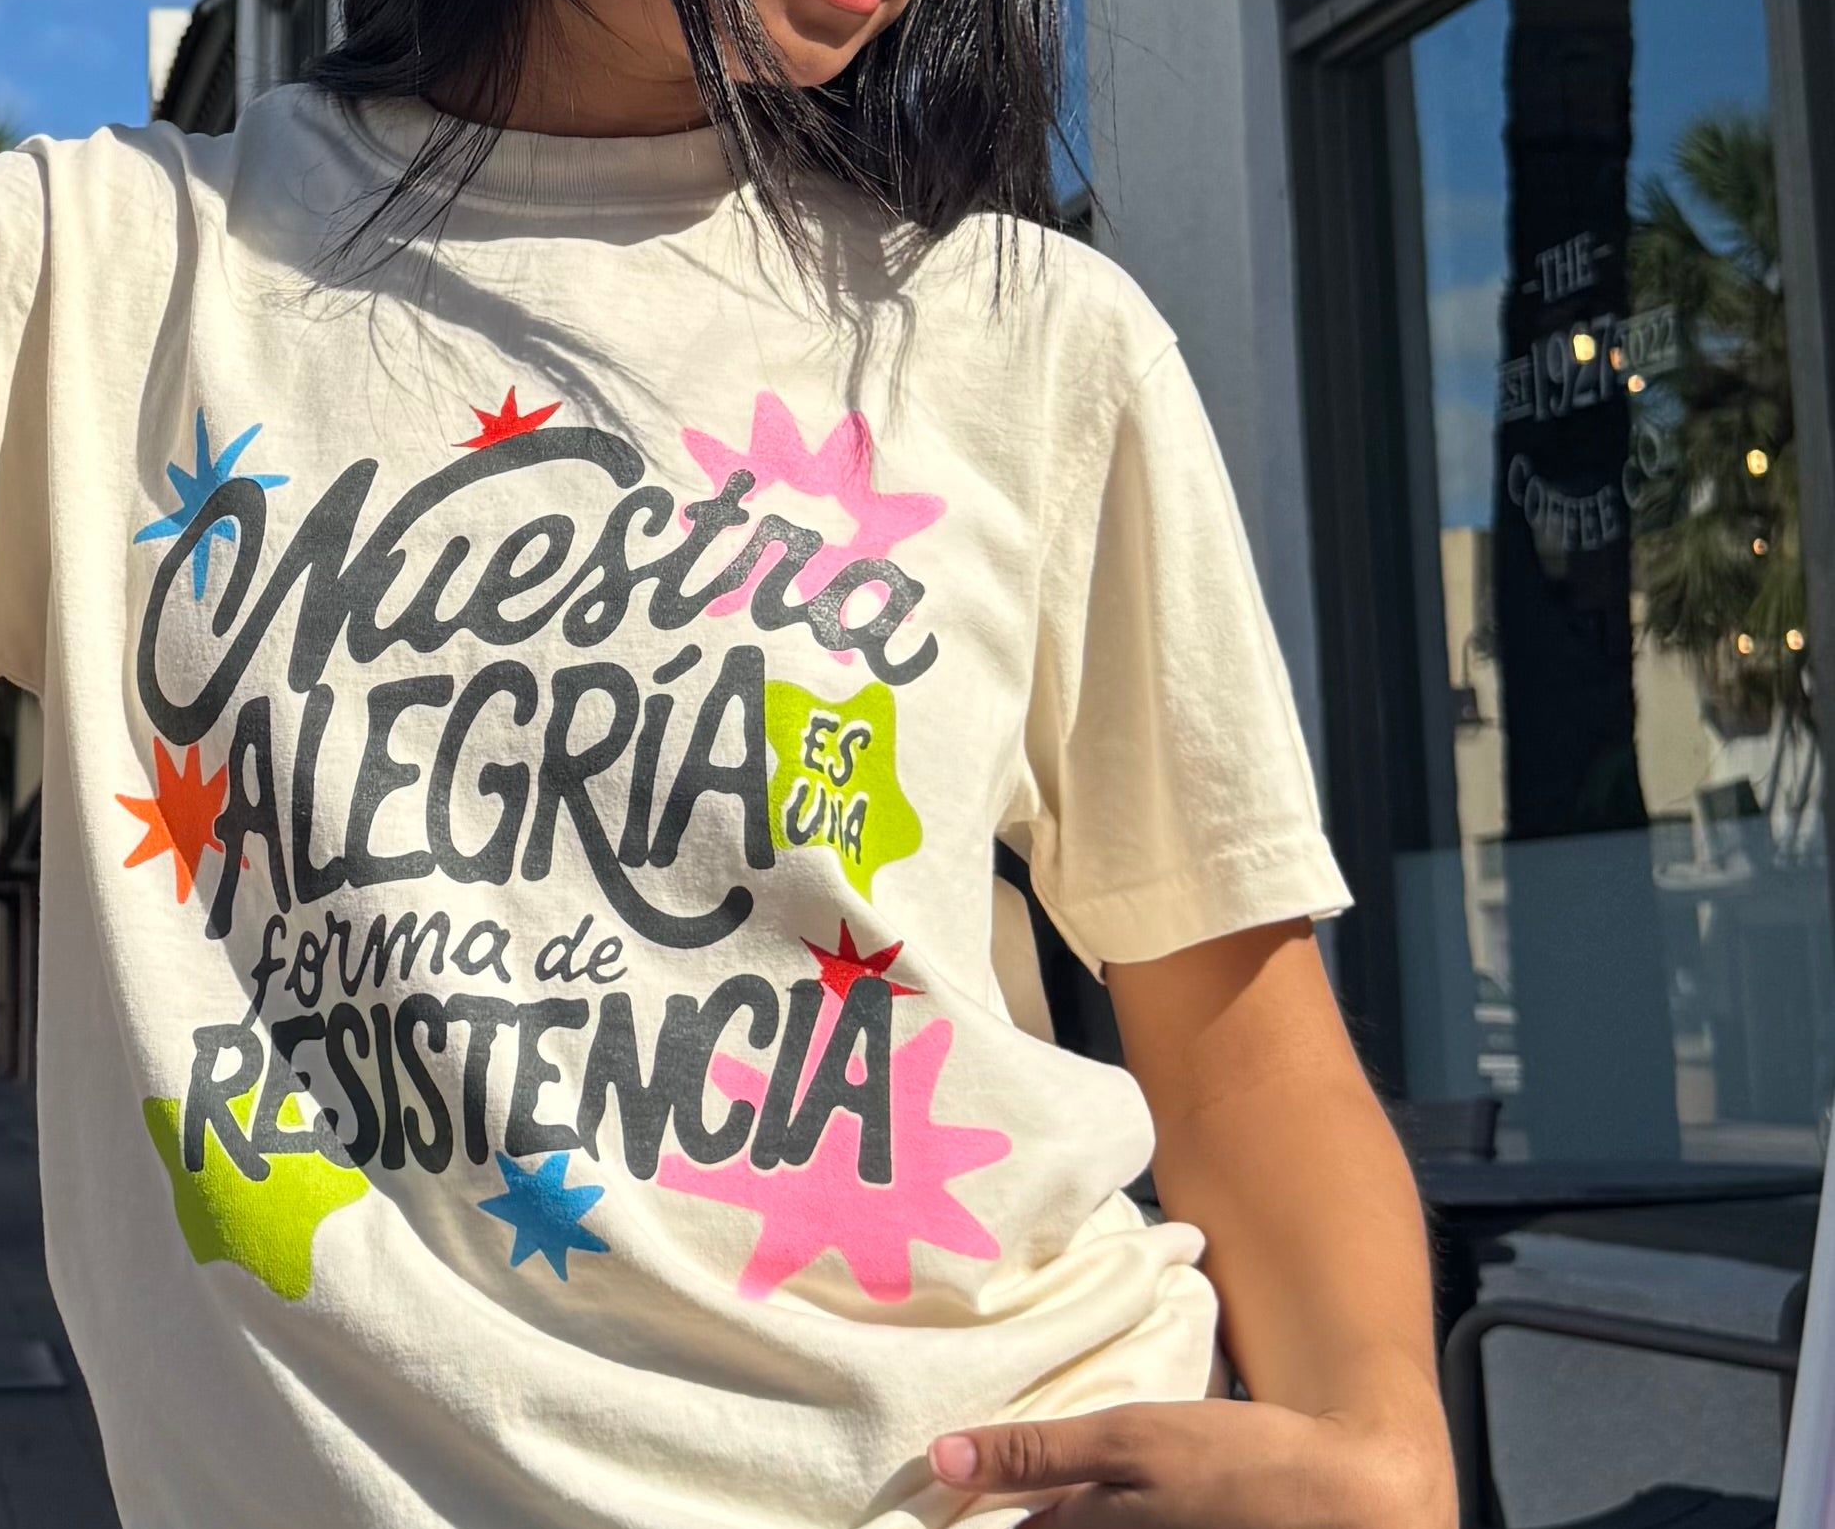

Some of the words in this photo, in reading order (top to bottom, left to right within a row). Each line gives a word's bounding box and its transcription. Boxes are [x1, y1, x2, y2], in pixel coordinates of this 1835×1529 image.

[1536, 231, 1597, 303] THE
[1532, 313, 1615, 421] 1927
[1508, 453, 1621, 551] COFFEE
[137, 427, 937, 746] Nuestra
[205, 645, 776, 949] ALEGRÍA
[803, 717, 871, 784] ES
[785, 789, 868, 865] UNA
[247, 911, 512, 1023] forma
[535, 914, 628, 983] de
[183, 974, 894, 1184] RESISTENCIA
